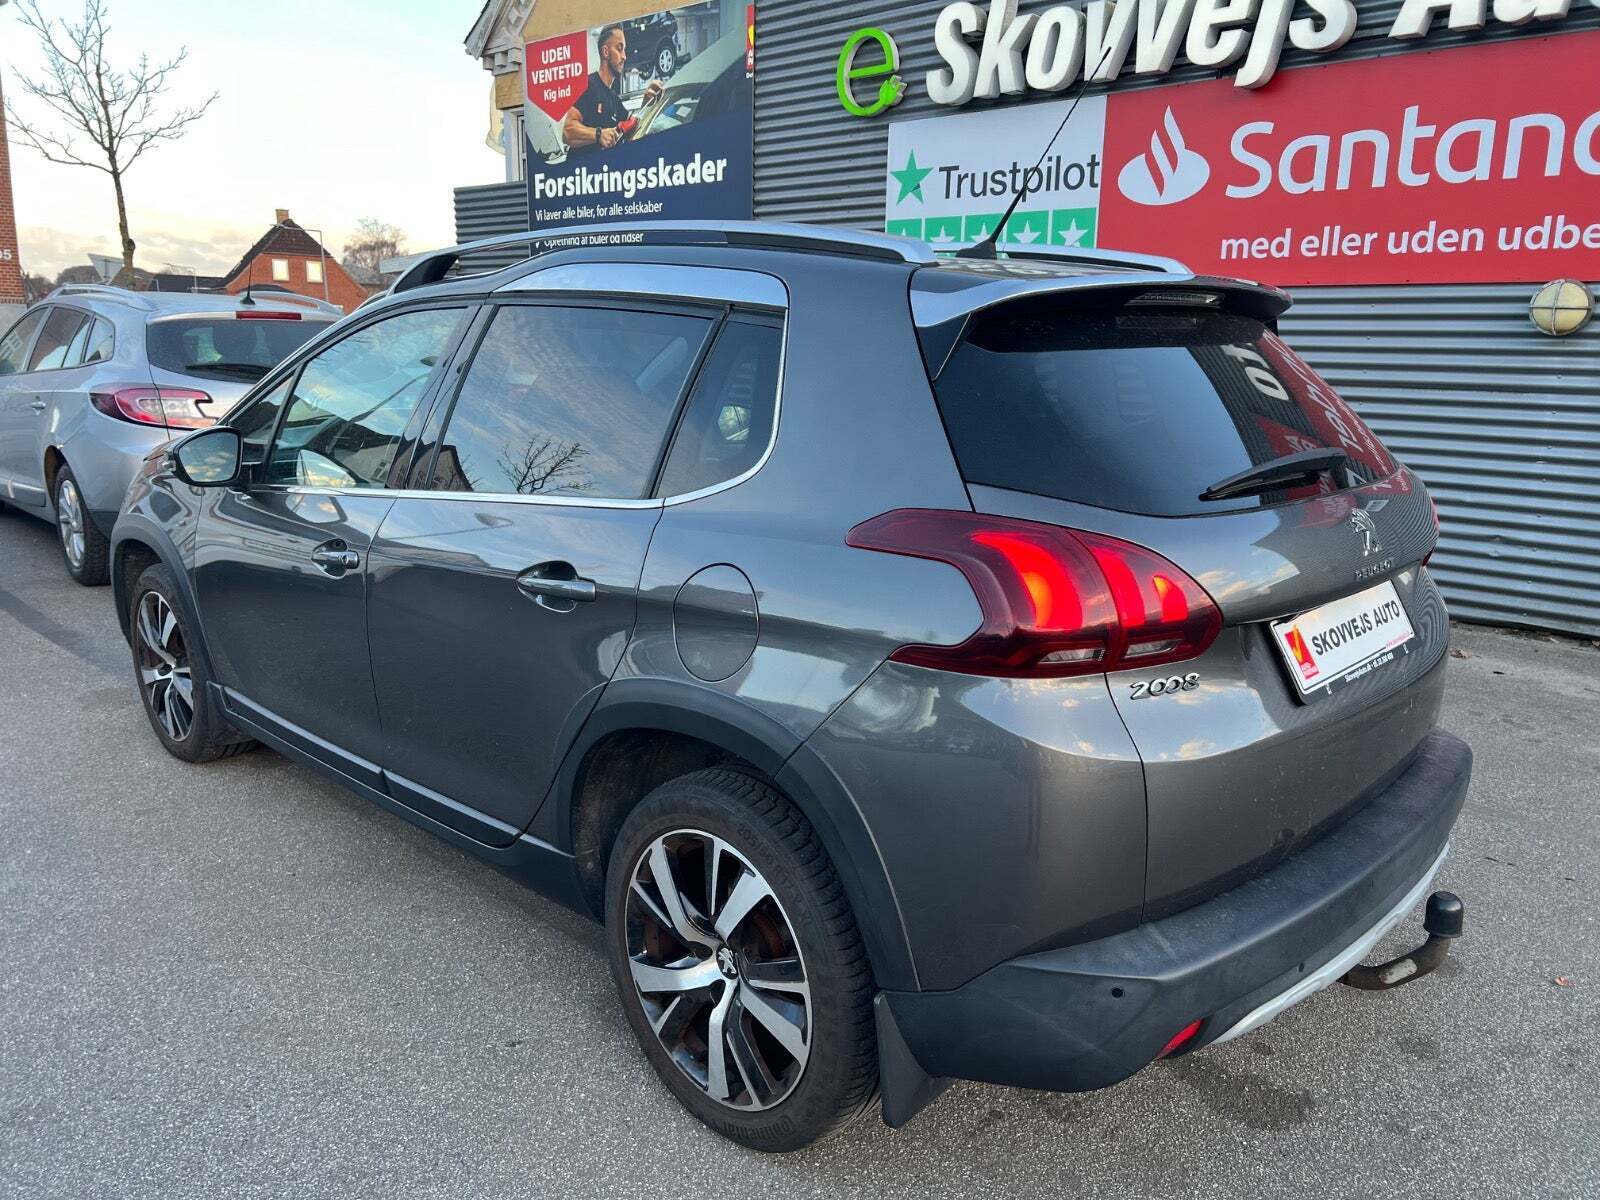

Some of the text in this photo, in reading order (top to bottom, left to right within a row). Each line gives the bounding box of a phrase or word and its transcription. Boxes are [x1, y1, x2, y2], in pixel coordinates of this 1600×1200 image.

[541, 45, 571, 64] UDEN
[531, 62, 583, 85] VENTETID
[543, 84, 571, 102] Kig ind
[534, 152, 728, 199] Forsikringsskader
[938, 153, 1100, 202] Trustpilot
[535, 200, 663, 221] Vi laver alle biler, for alle selskaber
[1220, 214, 1600, 260] med eller uden udbe
[1311, 612, 1373, 656] SKOVVEJS
[1372, 599, 1401, 628] AUTO
[1129, 672, 1200, 700] 2008
